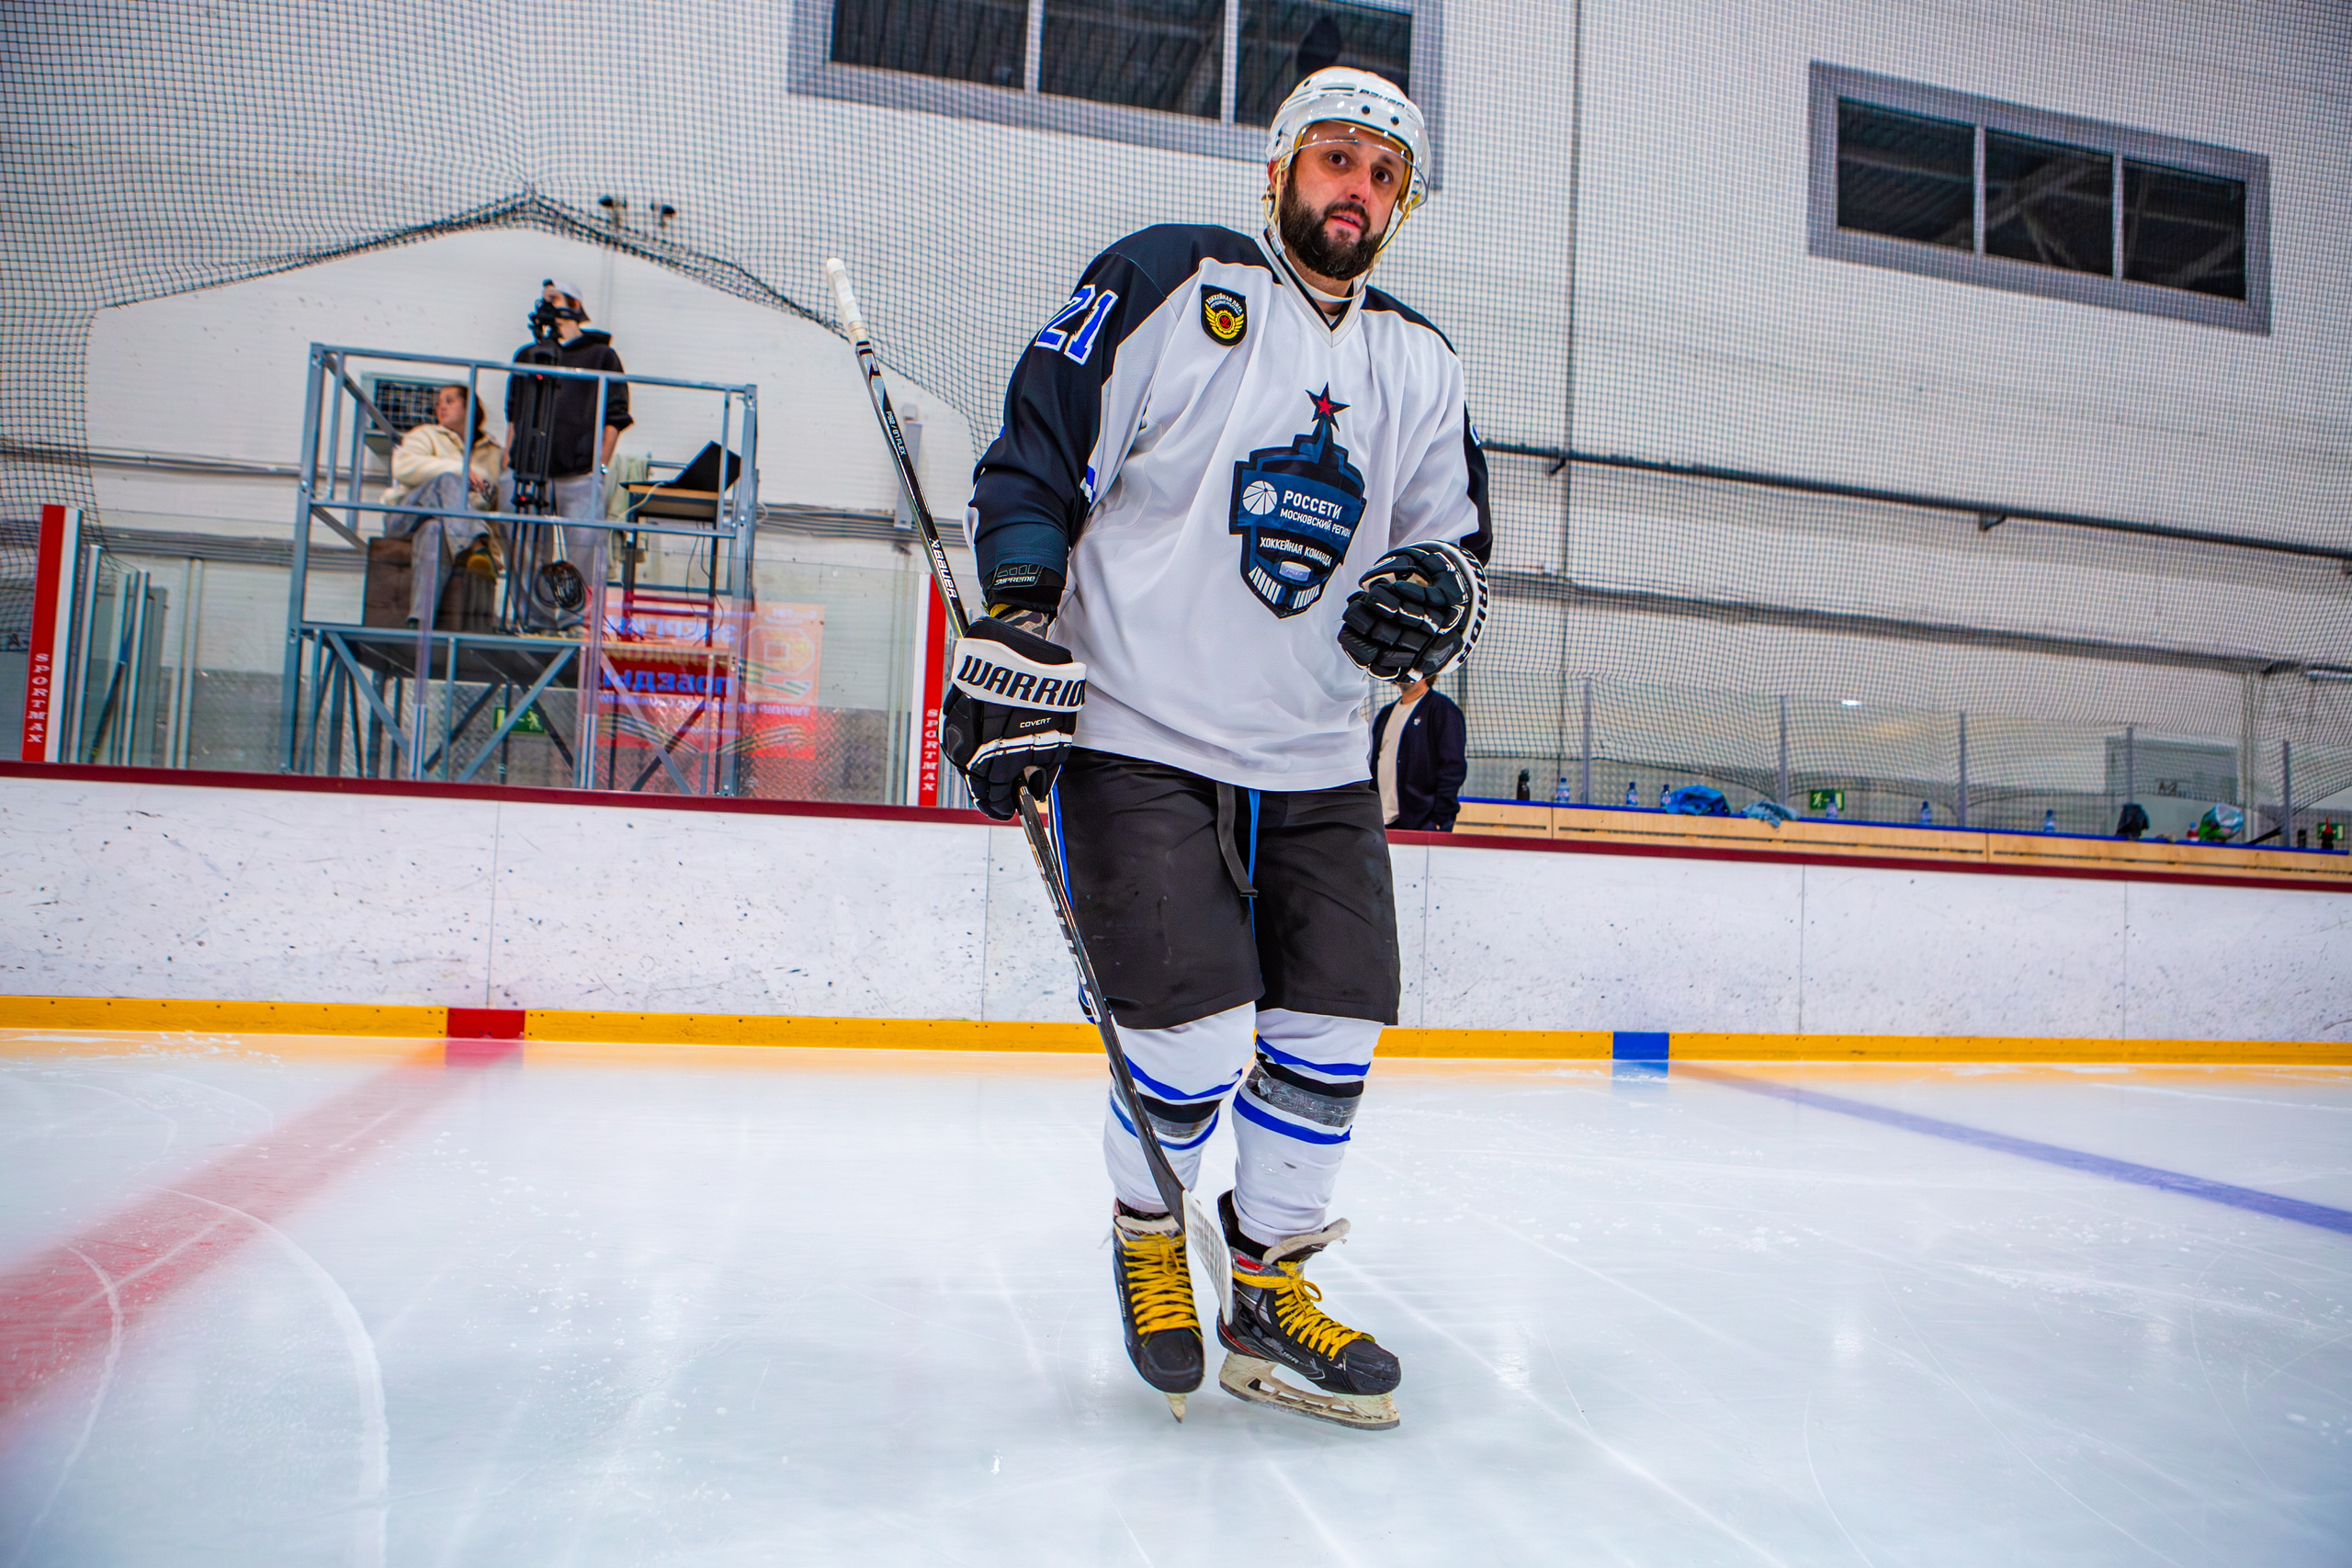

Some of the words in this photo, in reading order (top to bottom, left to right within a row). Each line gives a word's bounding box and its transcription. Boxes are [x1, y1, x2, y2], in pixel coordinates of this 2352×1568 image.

[1035, 284, 1119, 366] 21
[886, 411, 896, 425] P92
[895, 438, 907, 456] FLEX
[1280, 508, 1331, 531] МОСКОВСКИЙ
[1331, 524, 1352, 538] РЕГИОН
[1283, 490, 1343, 520] РОССЕТИ
[933, 548, 958, 598] BAUER
[1260, 536, 1303, 555] ХОККЕЙНАЯ
[1305, 546, 1332, 567] КОМАНДА
[26, 653, 51, 743] SPORTMAX
[1020, 717, 1052, 728] COVERT
[922, 708, 938, 791] SPORTMAX
